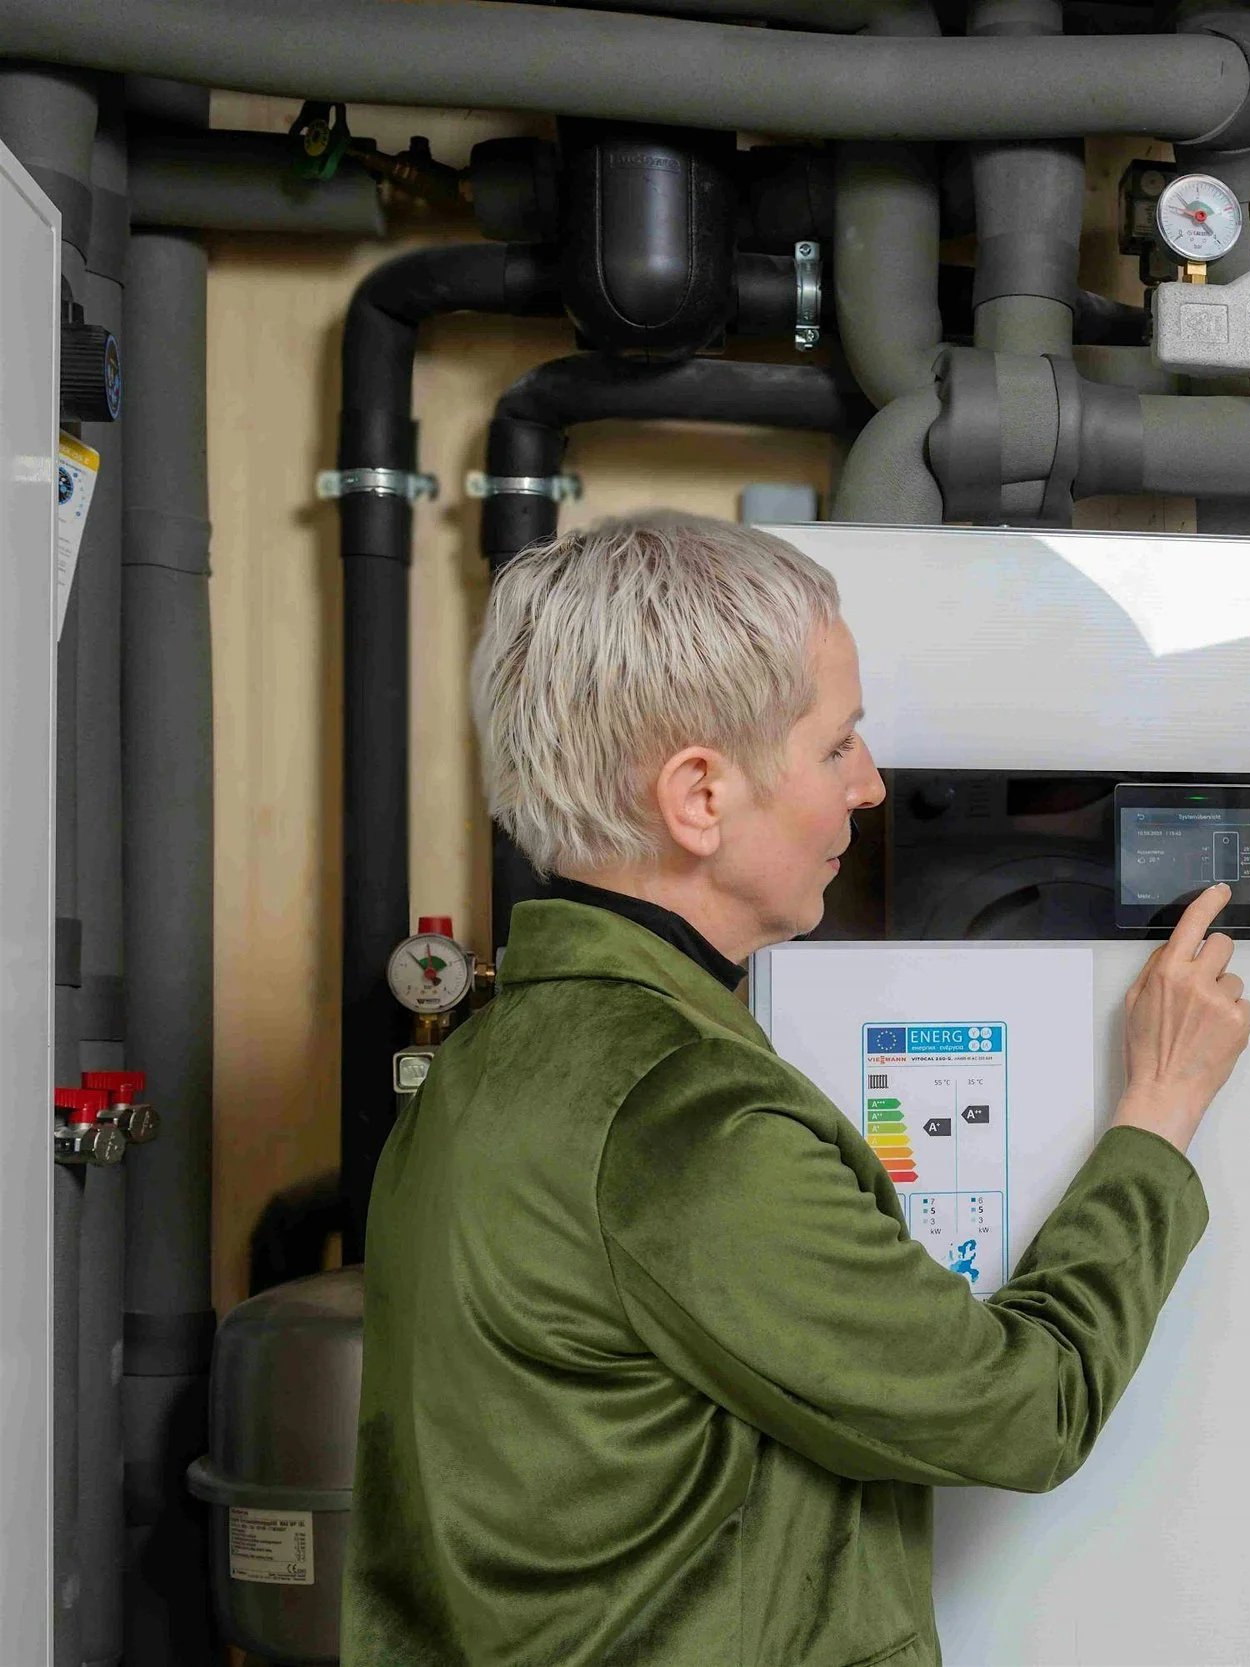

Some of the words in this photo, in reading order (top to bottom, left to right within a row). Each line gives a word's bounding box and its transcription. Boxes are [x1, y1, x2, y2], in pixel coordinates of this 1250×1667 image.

[911, 1031, 963, 1043] ENERG
[872, 1100, 886, 1108] A+++
[872, 1112, 883, 1120] A++
[966, 1109, 982, 1119] A++
[872, 1125, 880, 1133] A+
[928, 1122, 941, 1132] A+
